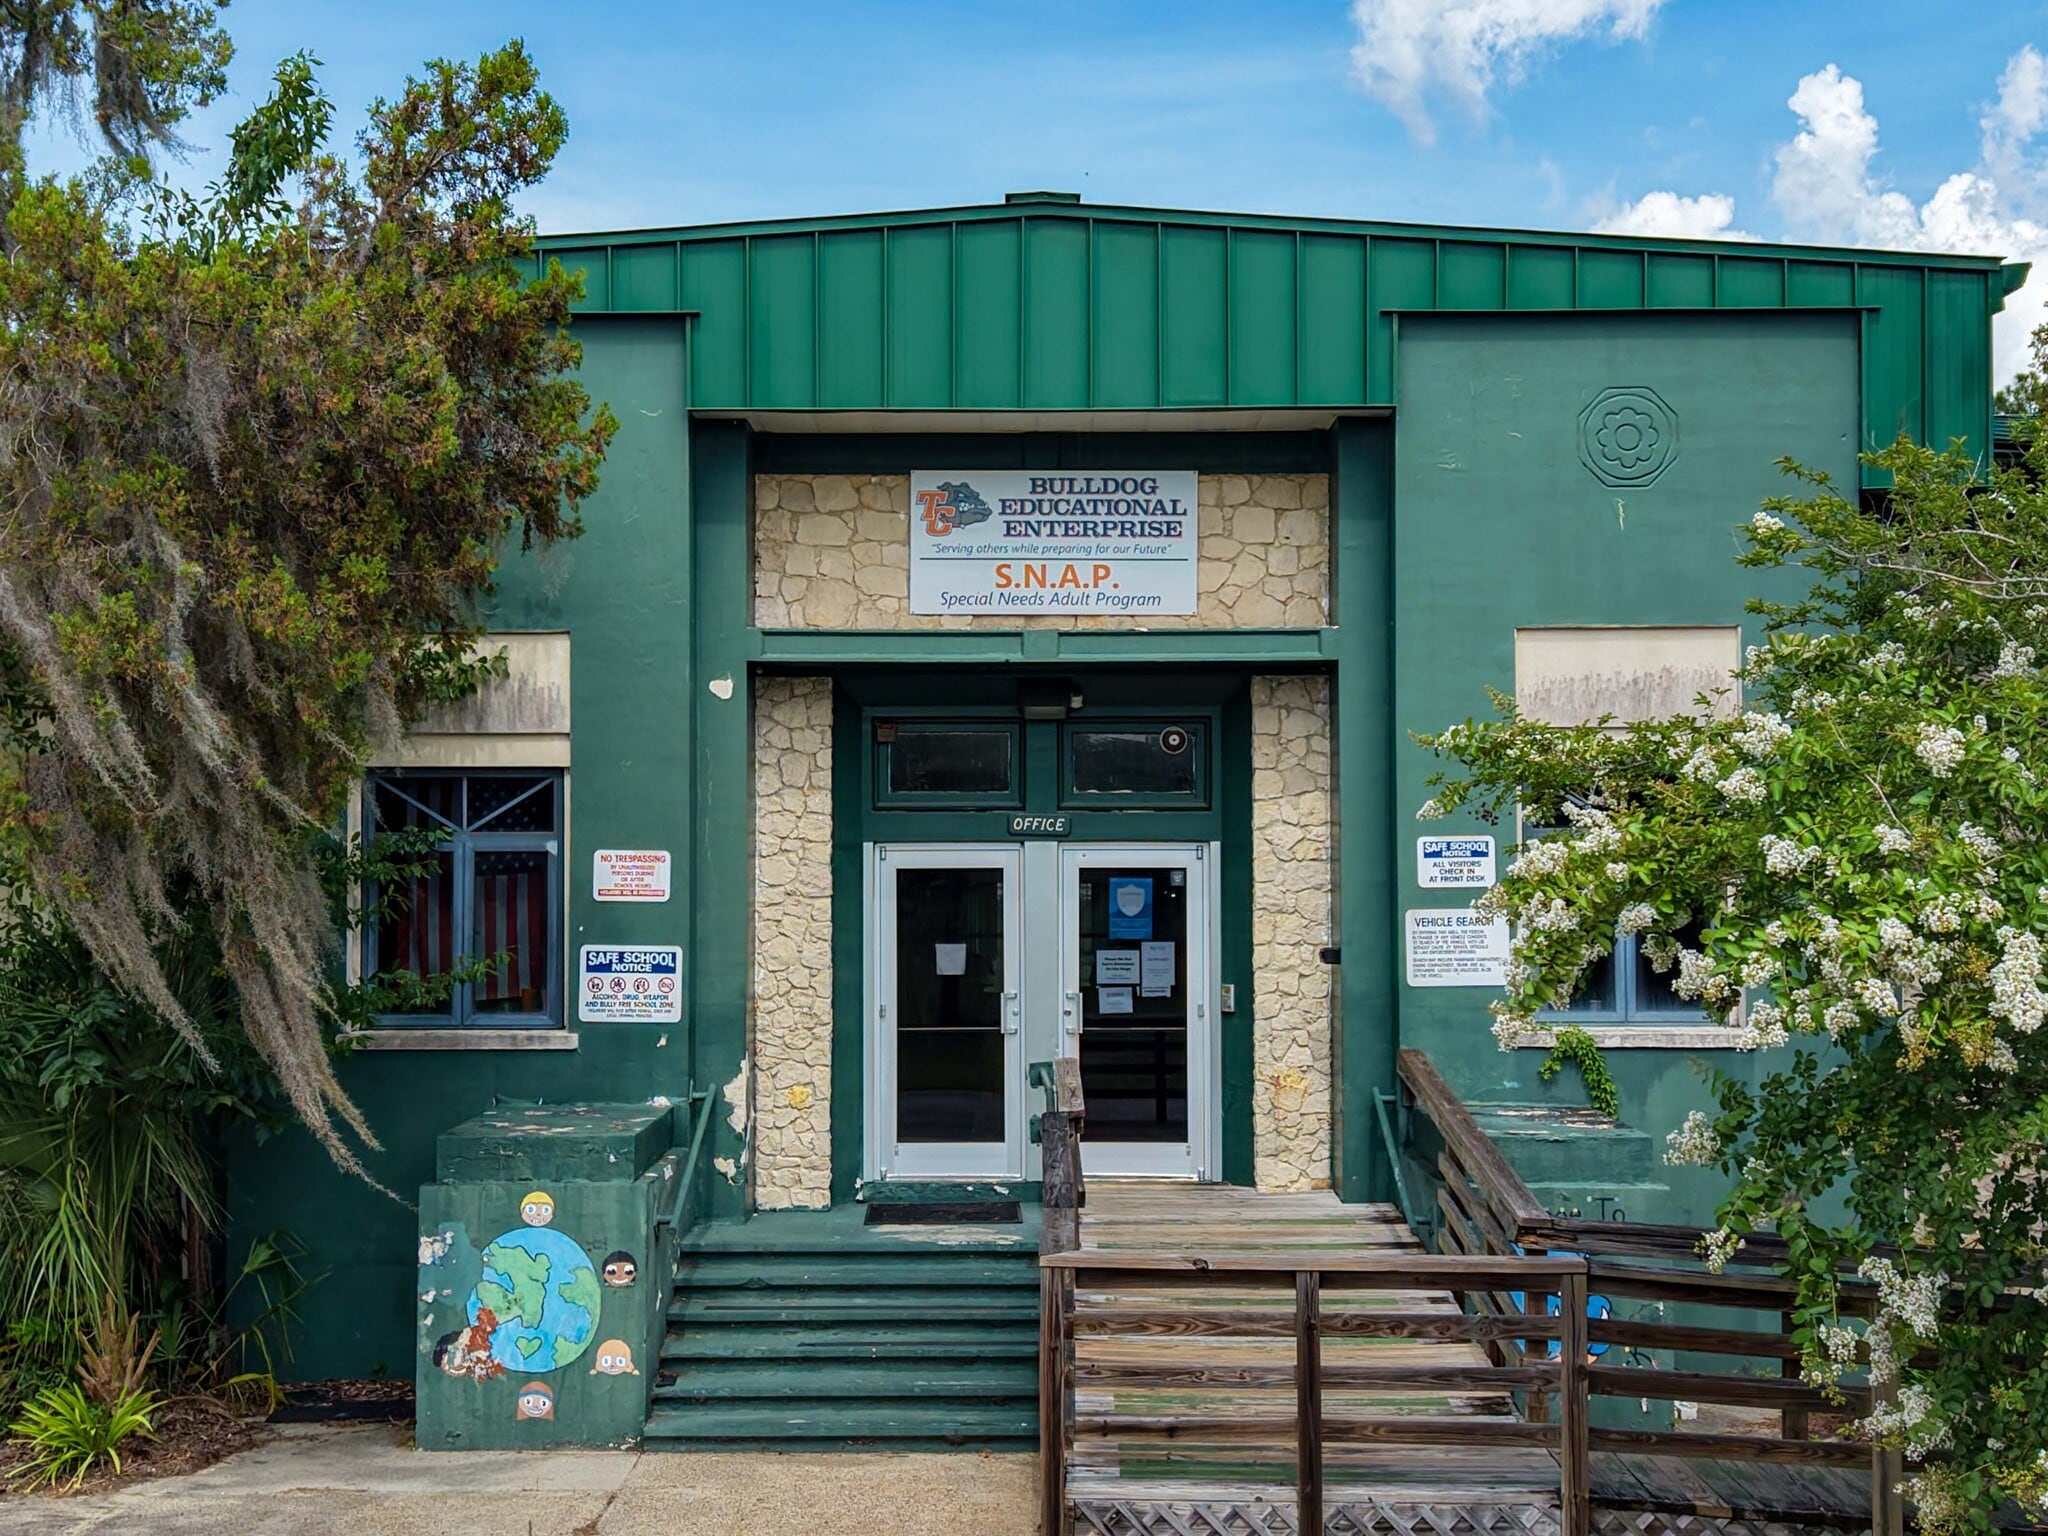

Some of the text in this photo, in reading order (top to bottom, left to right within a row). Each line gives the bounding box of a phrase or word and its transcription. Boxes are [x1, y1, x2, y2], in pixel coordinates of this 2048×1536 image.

[1029, 477, 1160, 495] BULLDOG
[998, 498, 1188, 516] EDUCATIONAL
[1003, 520, 1183, 538] ENTERPRISE
[976, 543, 1009, 554] others
[1011, 543, 1039, 554] while
[1041, 544, 1092, 556] preparing
[1093, 543, 1109, 556] for
[1112, 546, 1130, 554] our
[995, 563, 1120, 589] S.N.A.P.
[940, 591, 1161, 609] Special Needs Adult Program
[1013, 817, 1065, 831] OFFICE
[1424, 842, 1488, 853] SAFE SCHOOL
[600, 854, 666, 863] NO TRESPASSING
[1448, 860, 1482, 868] VISITORS
[1414, 917, 1453, 927] VEHICLE
[588, 952, 674, 967] SAFE SCHOOL
[612, 963, 652, 972] NOTICE
